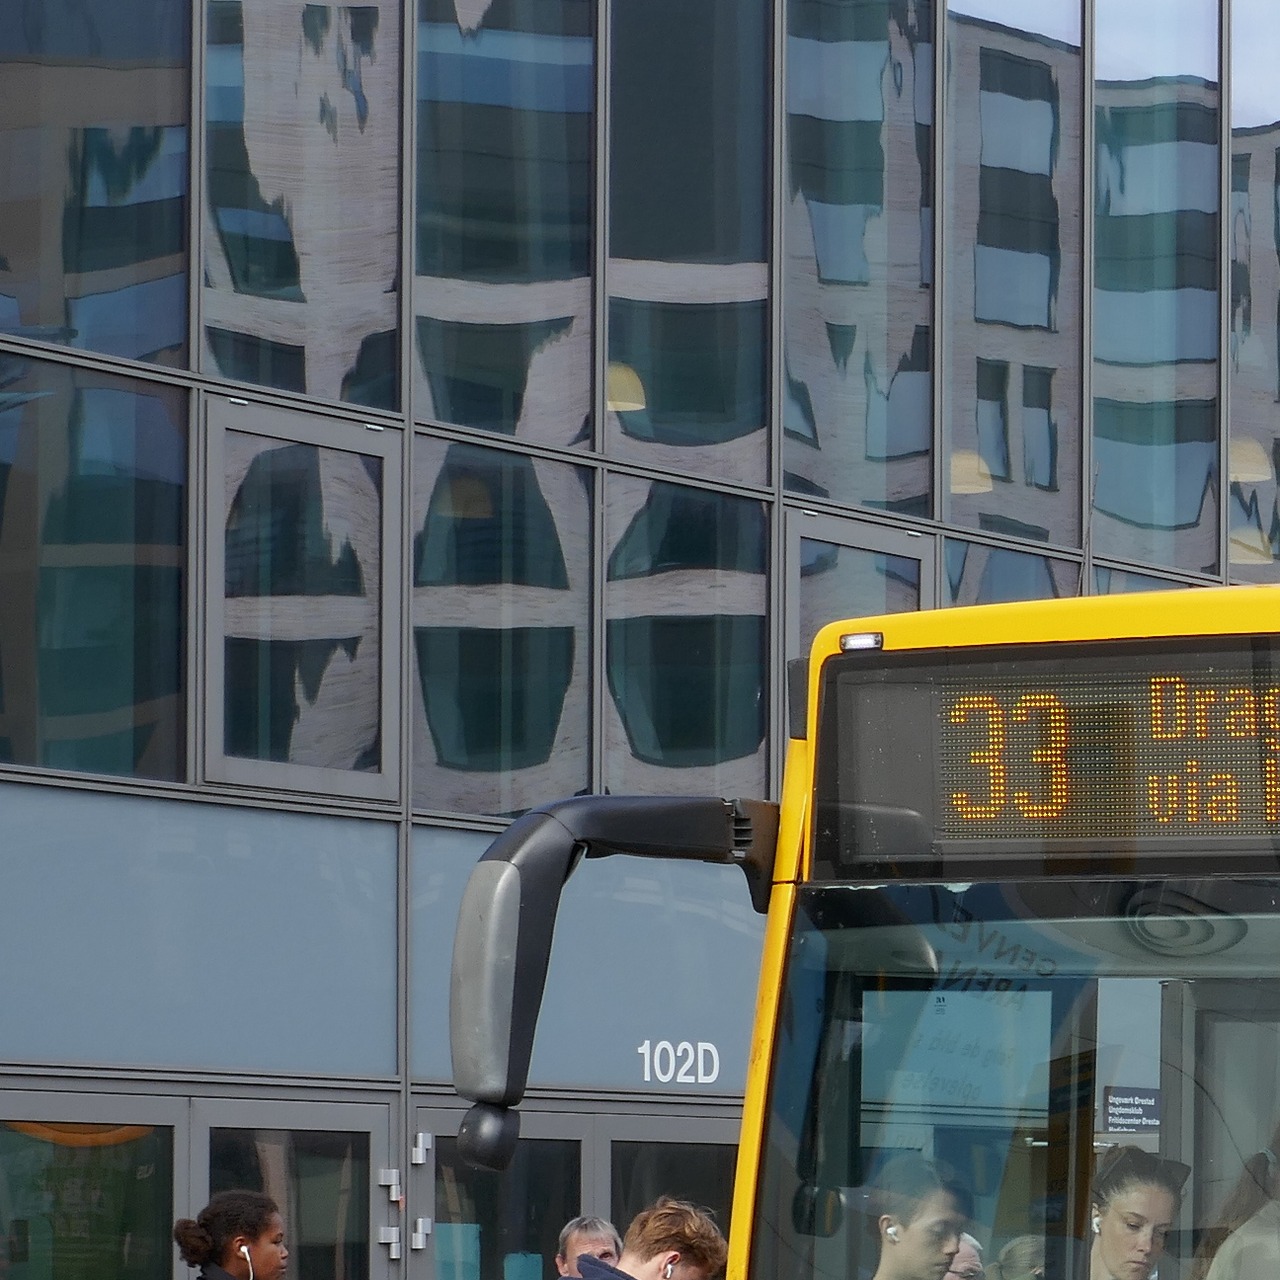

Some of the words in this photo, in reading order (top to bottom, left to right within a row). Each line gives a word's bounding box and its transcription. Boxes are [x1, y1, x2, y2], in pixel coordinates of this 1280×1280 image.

[950, 694, 1070, 819] 33
[1148, 760, 1238, 823] via
[637, 1040, 720, 1083] 102D
